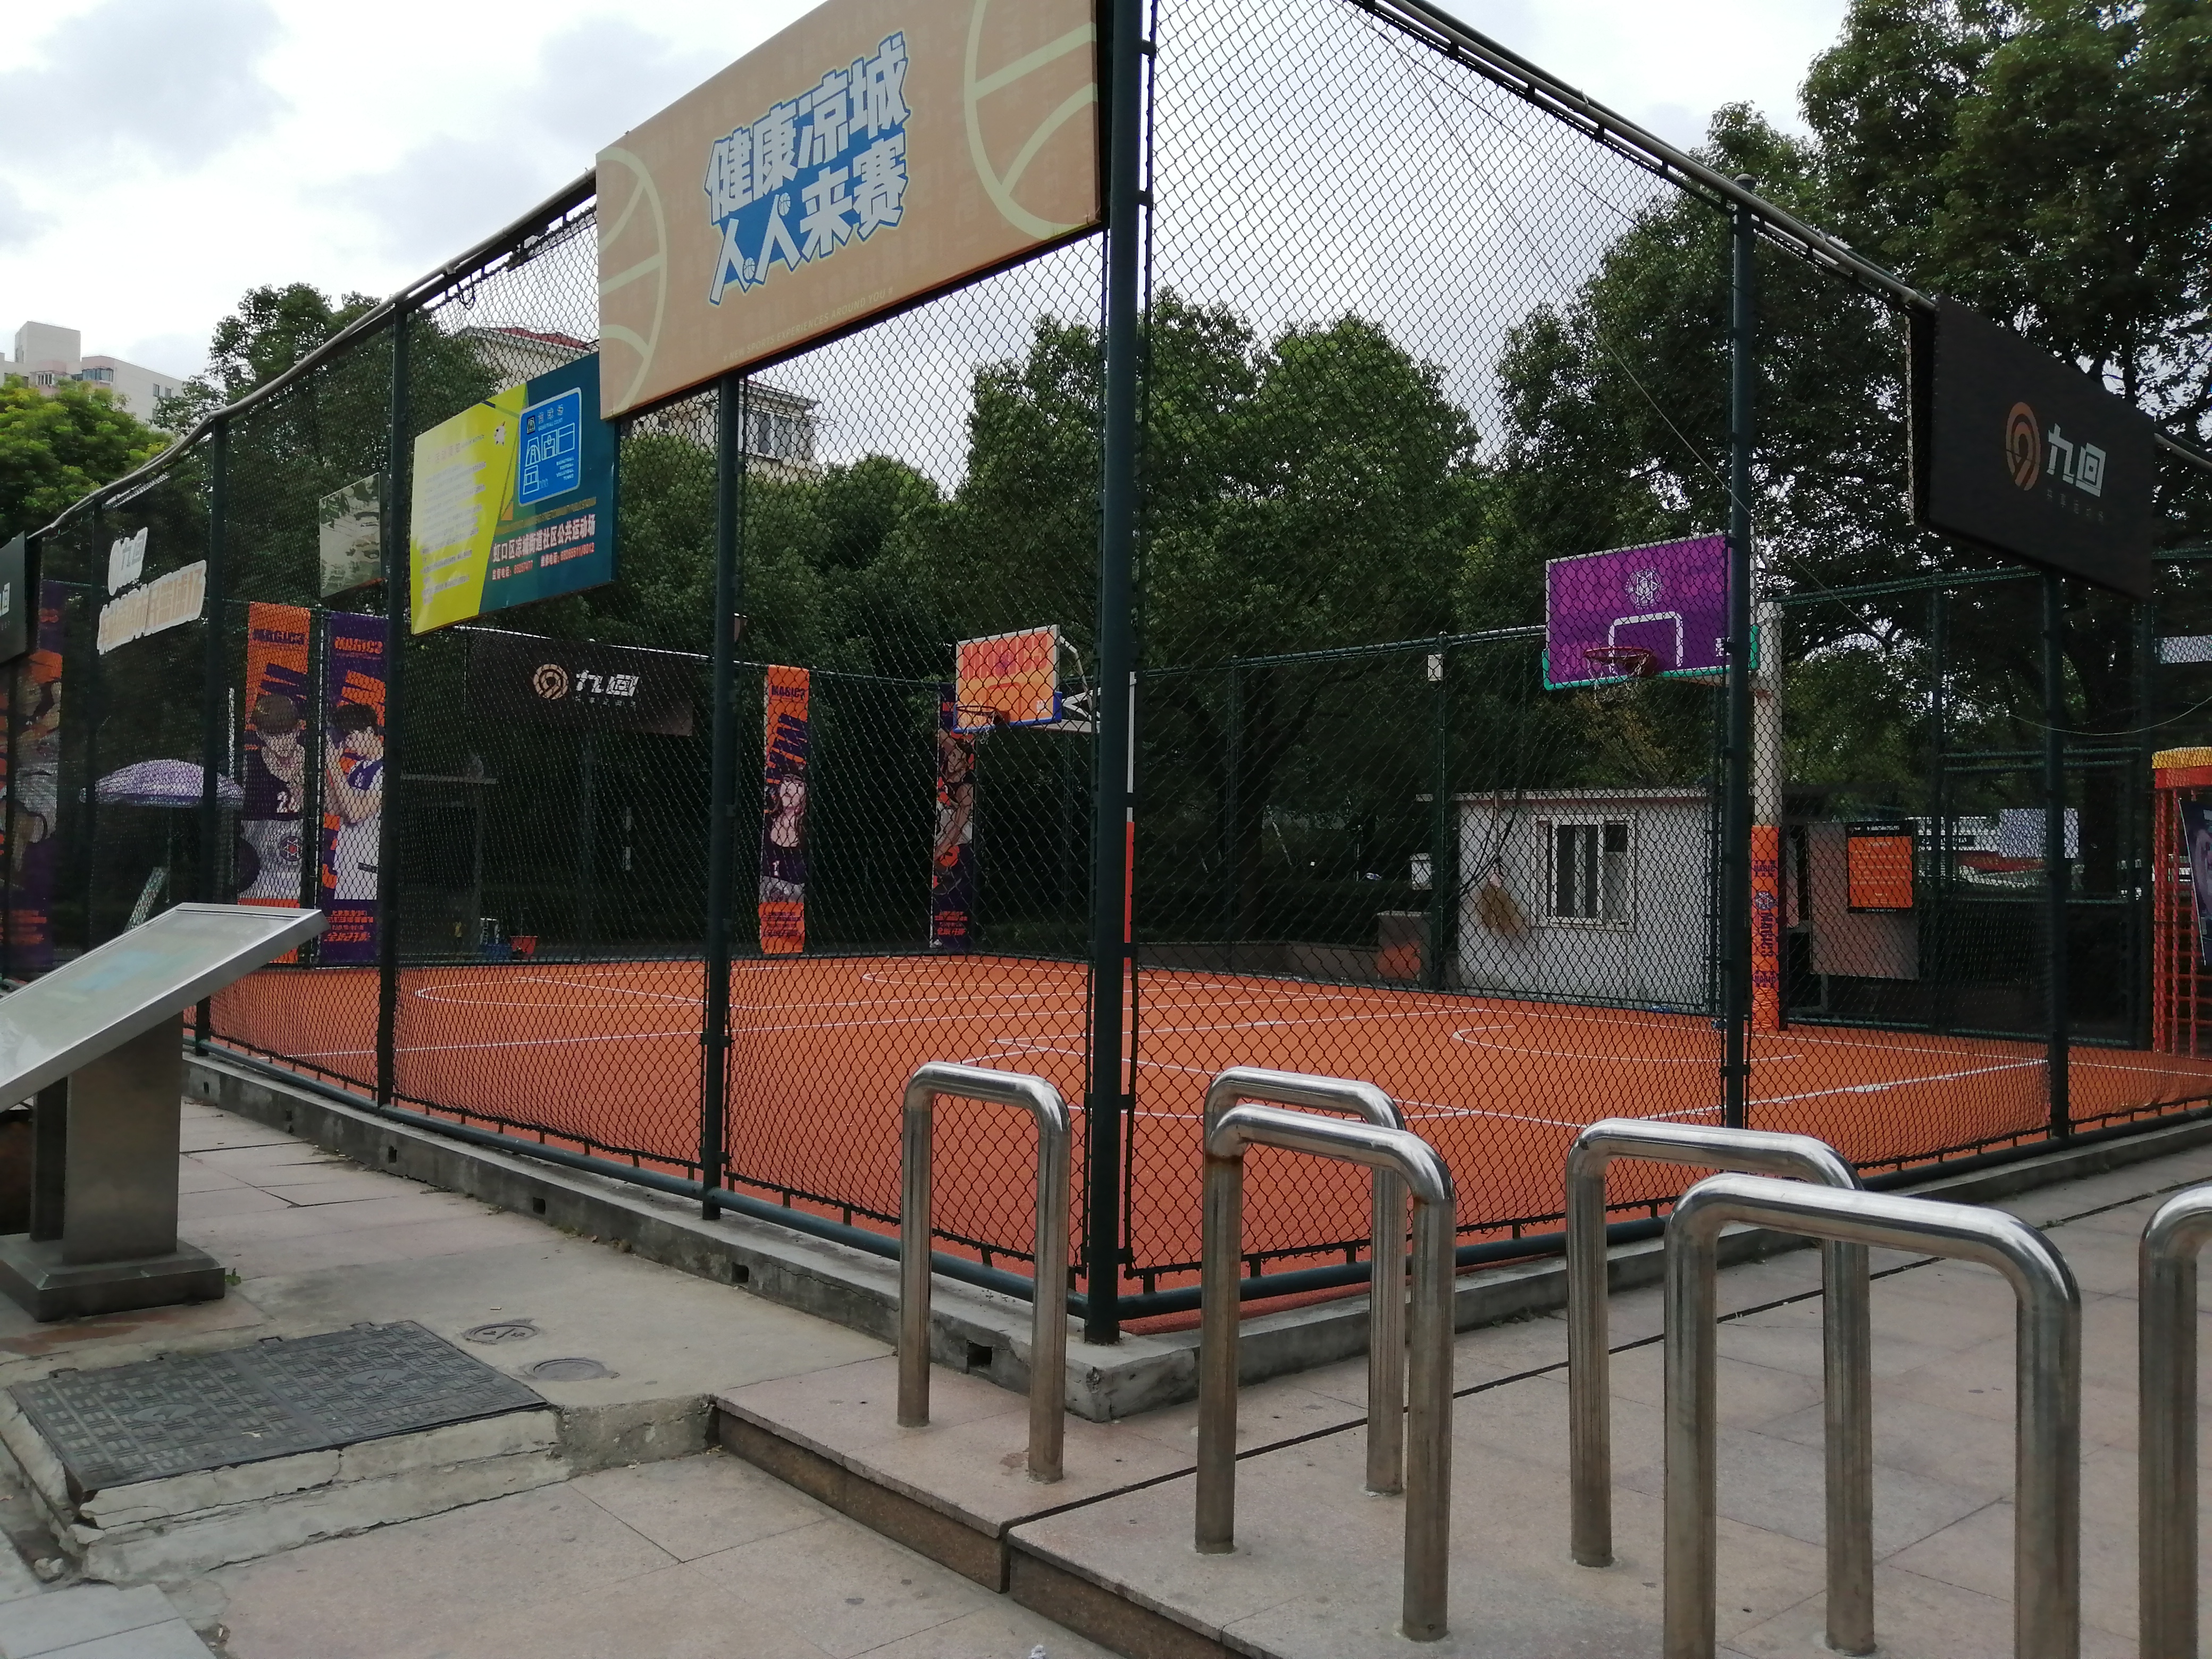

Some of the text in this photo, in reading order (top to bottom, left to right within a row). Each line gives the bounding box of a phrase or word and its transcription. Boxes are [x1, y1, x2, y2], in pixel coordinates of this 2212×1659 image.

[705, 32, 910, 224] 健康凉城
[709, 133, 907, 305] 人人来赛
[730, 348, 744, 361] NEW
[747, 337, 775, 354] SPORTS
[777, 313, 828, 341] EXPERIENCES
[831, 297, 866, 319] AROUND
[868, 289, 886, 304] YOU
[2048, 423, 2106, 498] 九回
[493, 514, 596, 563] 虹口区凉城街道社区公共运动场
[0, 582, 10, 617] 回
[576, 670, 639, 697] 九回
